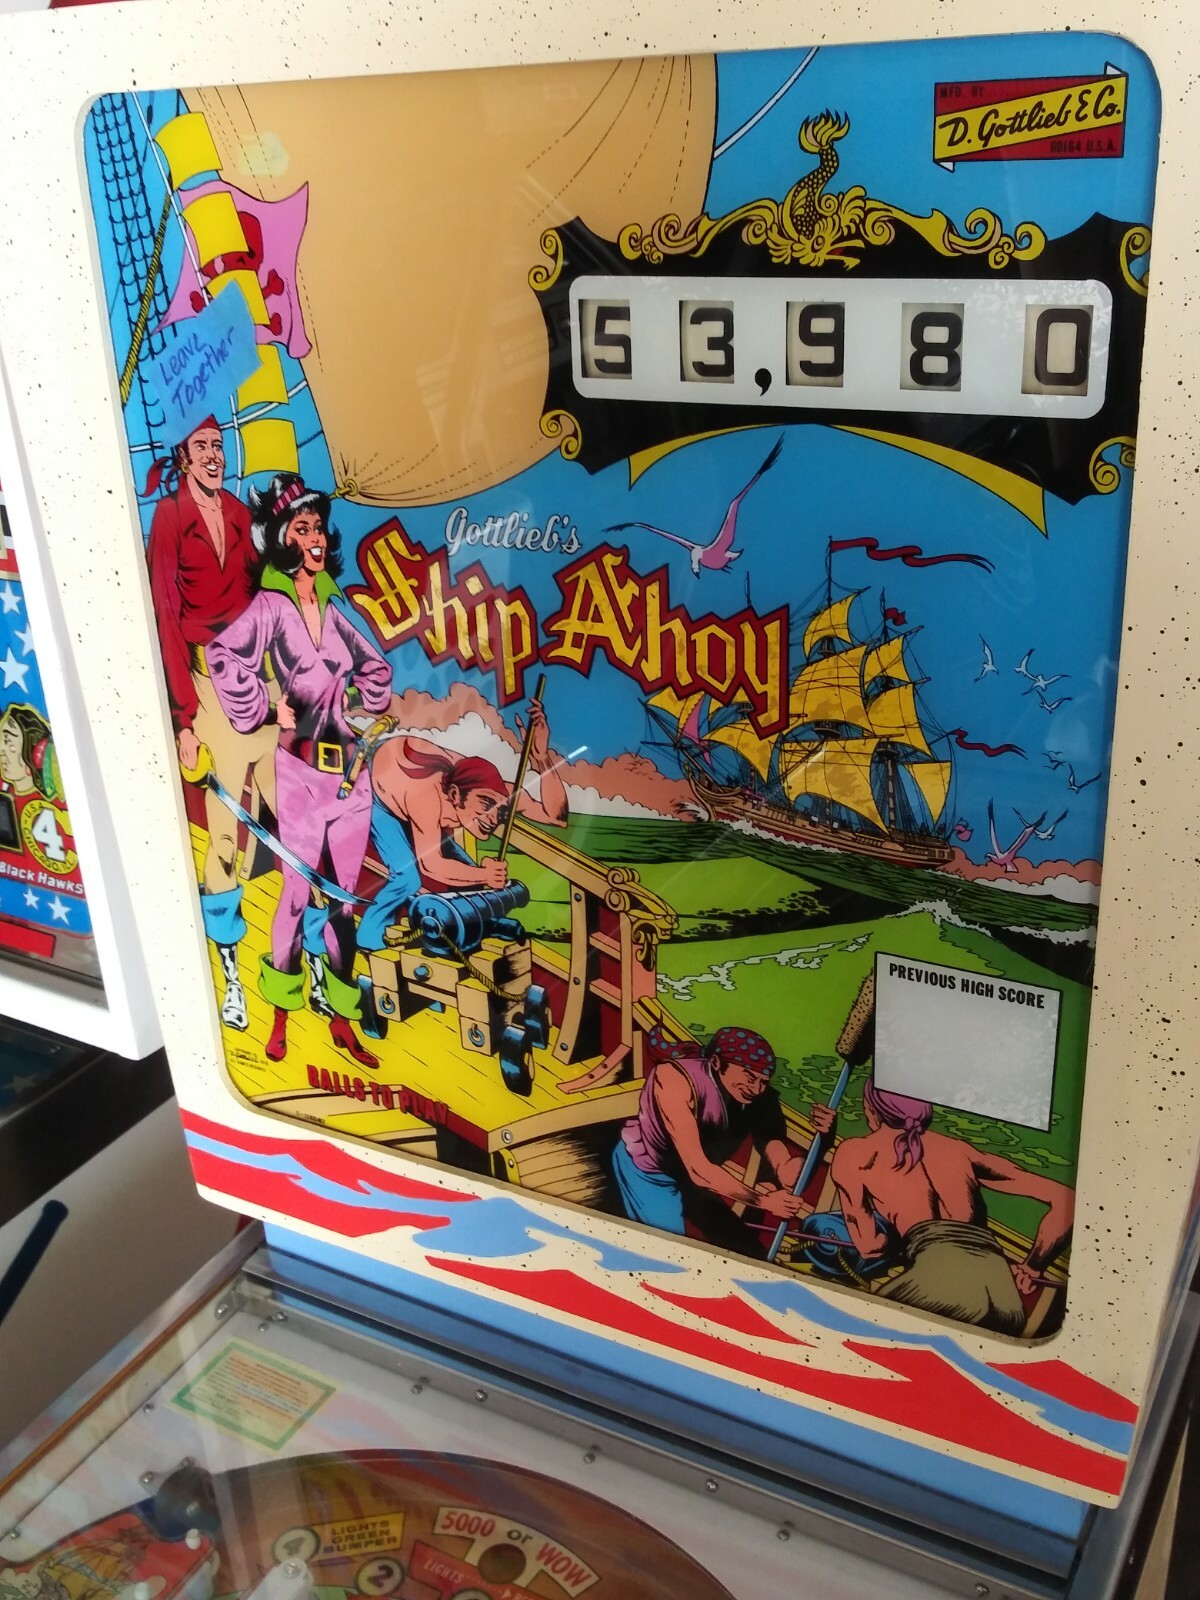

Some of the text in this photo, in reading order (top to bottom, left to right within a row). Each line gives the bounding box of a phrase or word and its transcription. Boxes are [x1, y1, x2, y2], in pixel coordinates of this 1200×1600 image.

[977, 93, 1073, 148] Gottlieb
[1093, 84, 1121, 119] Co.
[444, 506, 582, 556] Gottlieb's
[350, 524, 785, 733] Ship Ahoy
[32, 807, 66, 864] 4
[889, 962, 1045, 1009] PREVIOUS HIGH SCORE
[306, 1064, 449, 1125] BALLS TO PLAY
[331, 1520, 390, 1536] LIGHTS
[441, 1512, 592, 1589] 5000 or WOW
